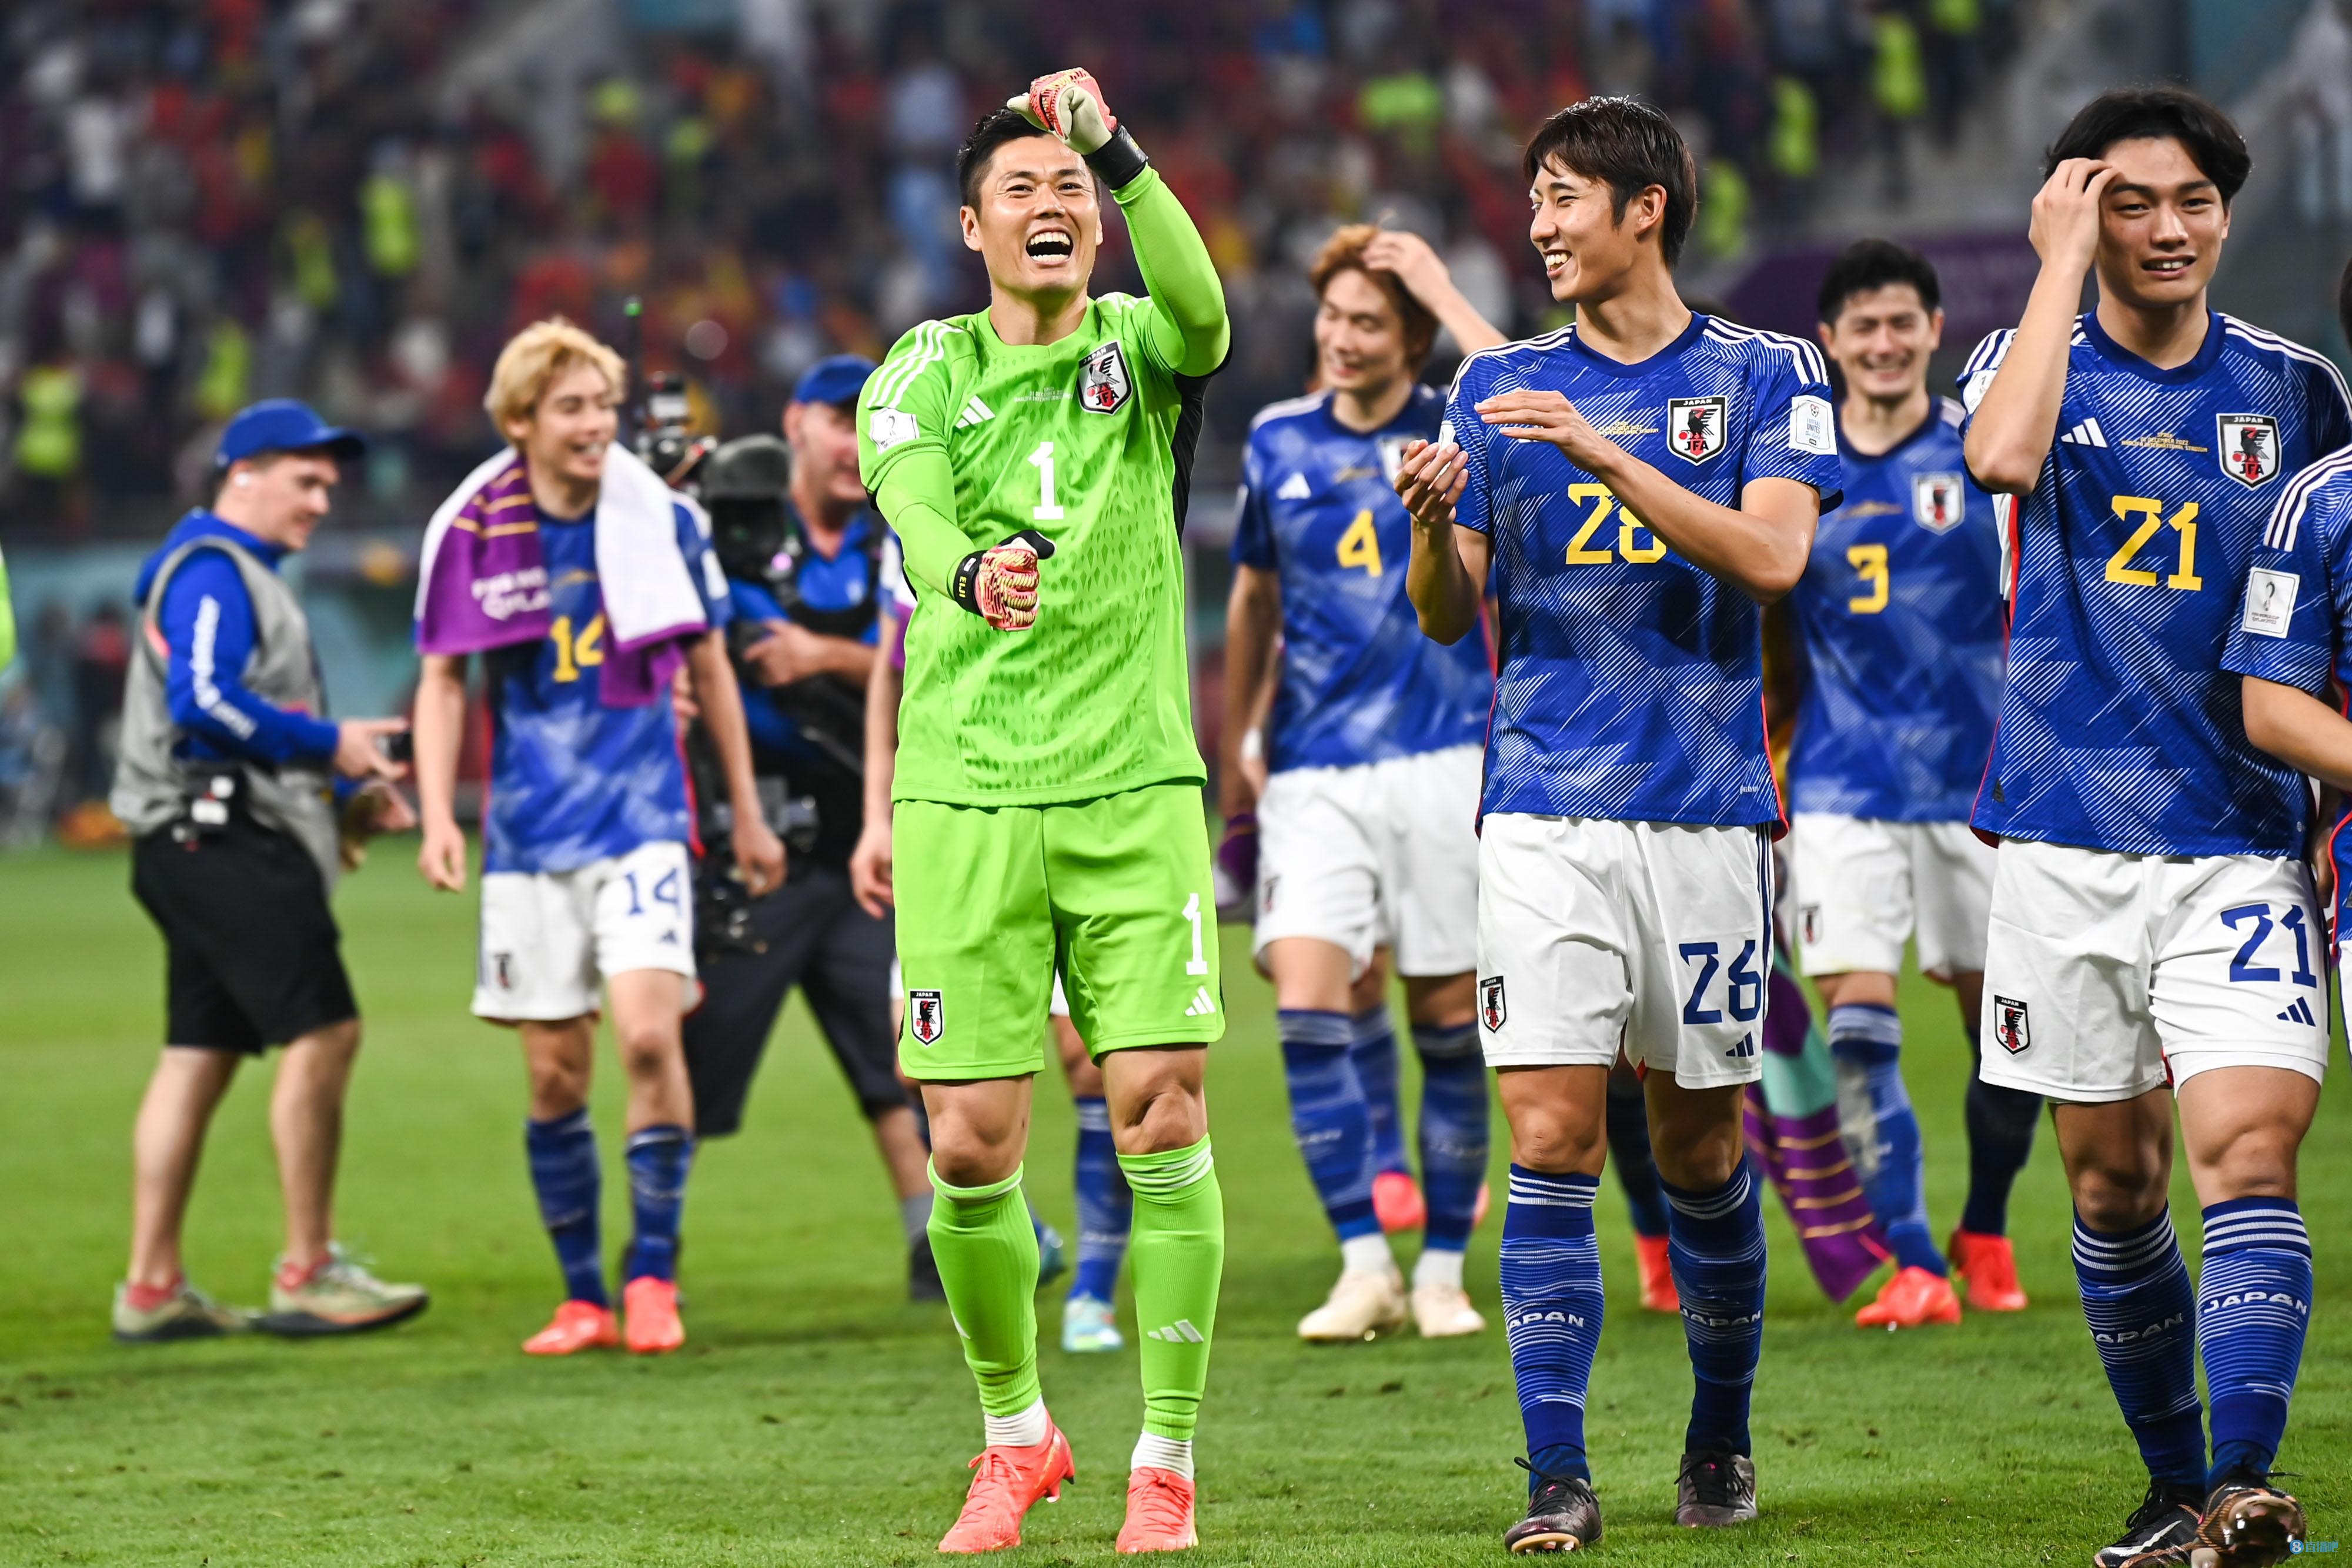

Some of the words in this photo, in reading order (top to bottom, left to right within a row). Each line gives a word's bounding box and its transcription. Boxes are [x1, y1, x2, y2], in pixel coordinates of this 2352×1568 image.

[1084, 347, 1107, 364] JAPAN
[1096, 389, 1120, 406] JFA
[1685, 440, 1709, 451] JFA
[1028, 442, 1064, 520] 1
[2240, 463, 2264, 474] JFA
[1337, 509, 1382, 577] 4
[2105, 495, 2202, 591] 21
[958, 576, 967, 598] EIJI
[1847, 543, 1889, 614] 3
[624, 867, 680, 917] 14
[1182, 893, 1208, 975] 1
[2220, 903, 2317, 988] 21
[1678, 940, 1762, 1025] 26
[2001, 998, 2019, 1007] JAPAN
[2204, 1292, 2307, 1315] JAPAN
[1509, 1311, 1584, 1329] APAN
[2090, 1312, 2183, 1343] APAN
